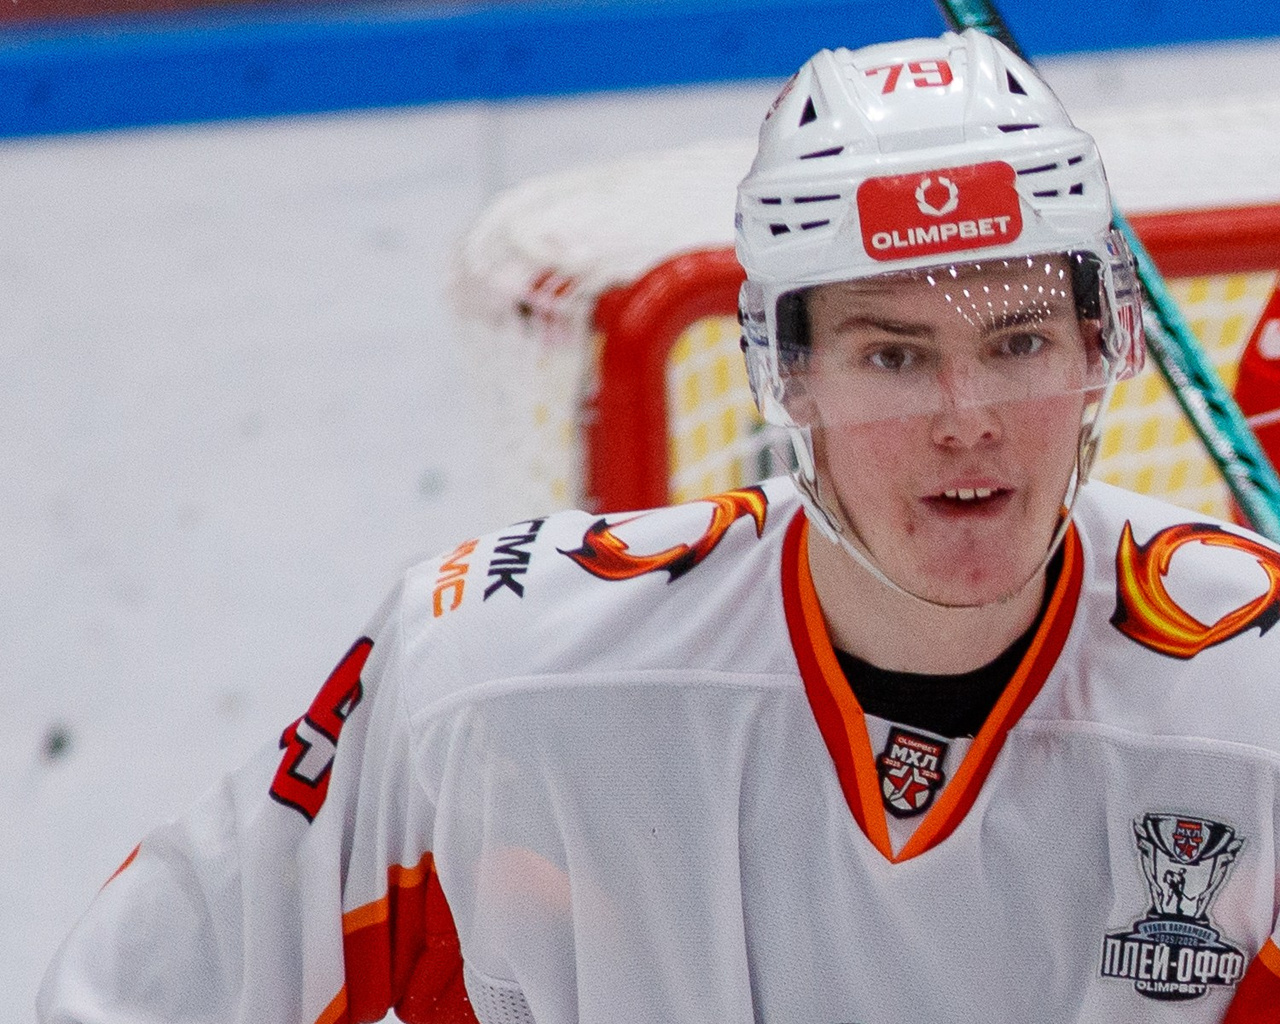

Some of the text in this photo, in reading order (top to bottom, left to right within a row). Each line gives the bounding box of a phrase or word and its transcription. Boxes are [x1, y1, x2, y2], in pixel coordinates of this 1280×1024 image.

[865, 59, 954, 95] 79
[871, 215, 1011, 250] OLIMPBET
[890, 743, 938, 772] МХЛ
[1103, 938, 1243, 983] ПЛЕЙ-ОФФ
[1136, 981, 1206, 994] OLIMPBET
